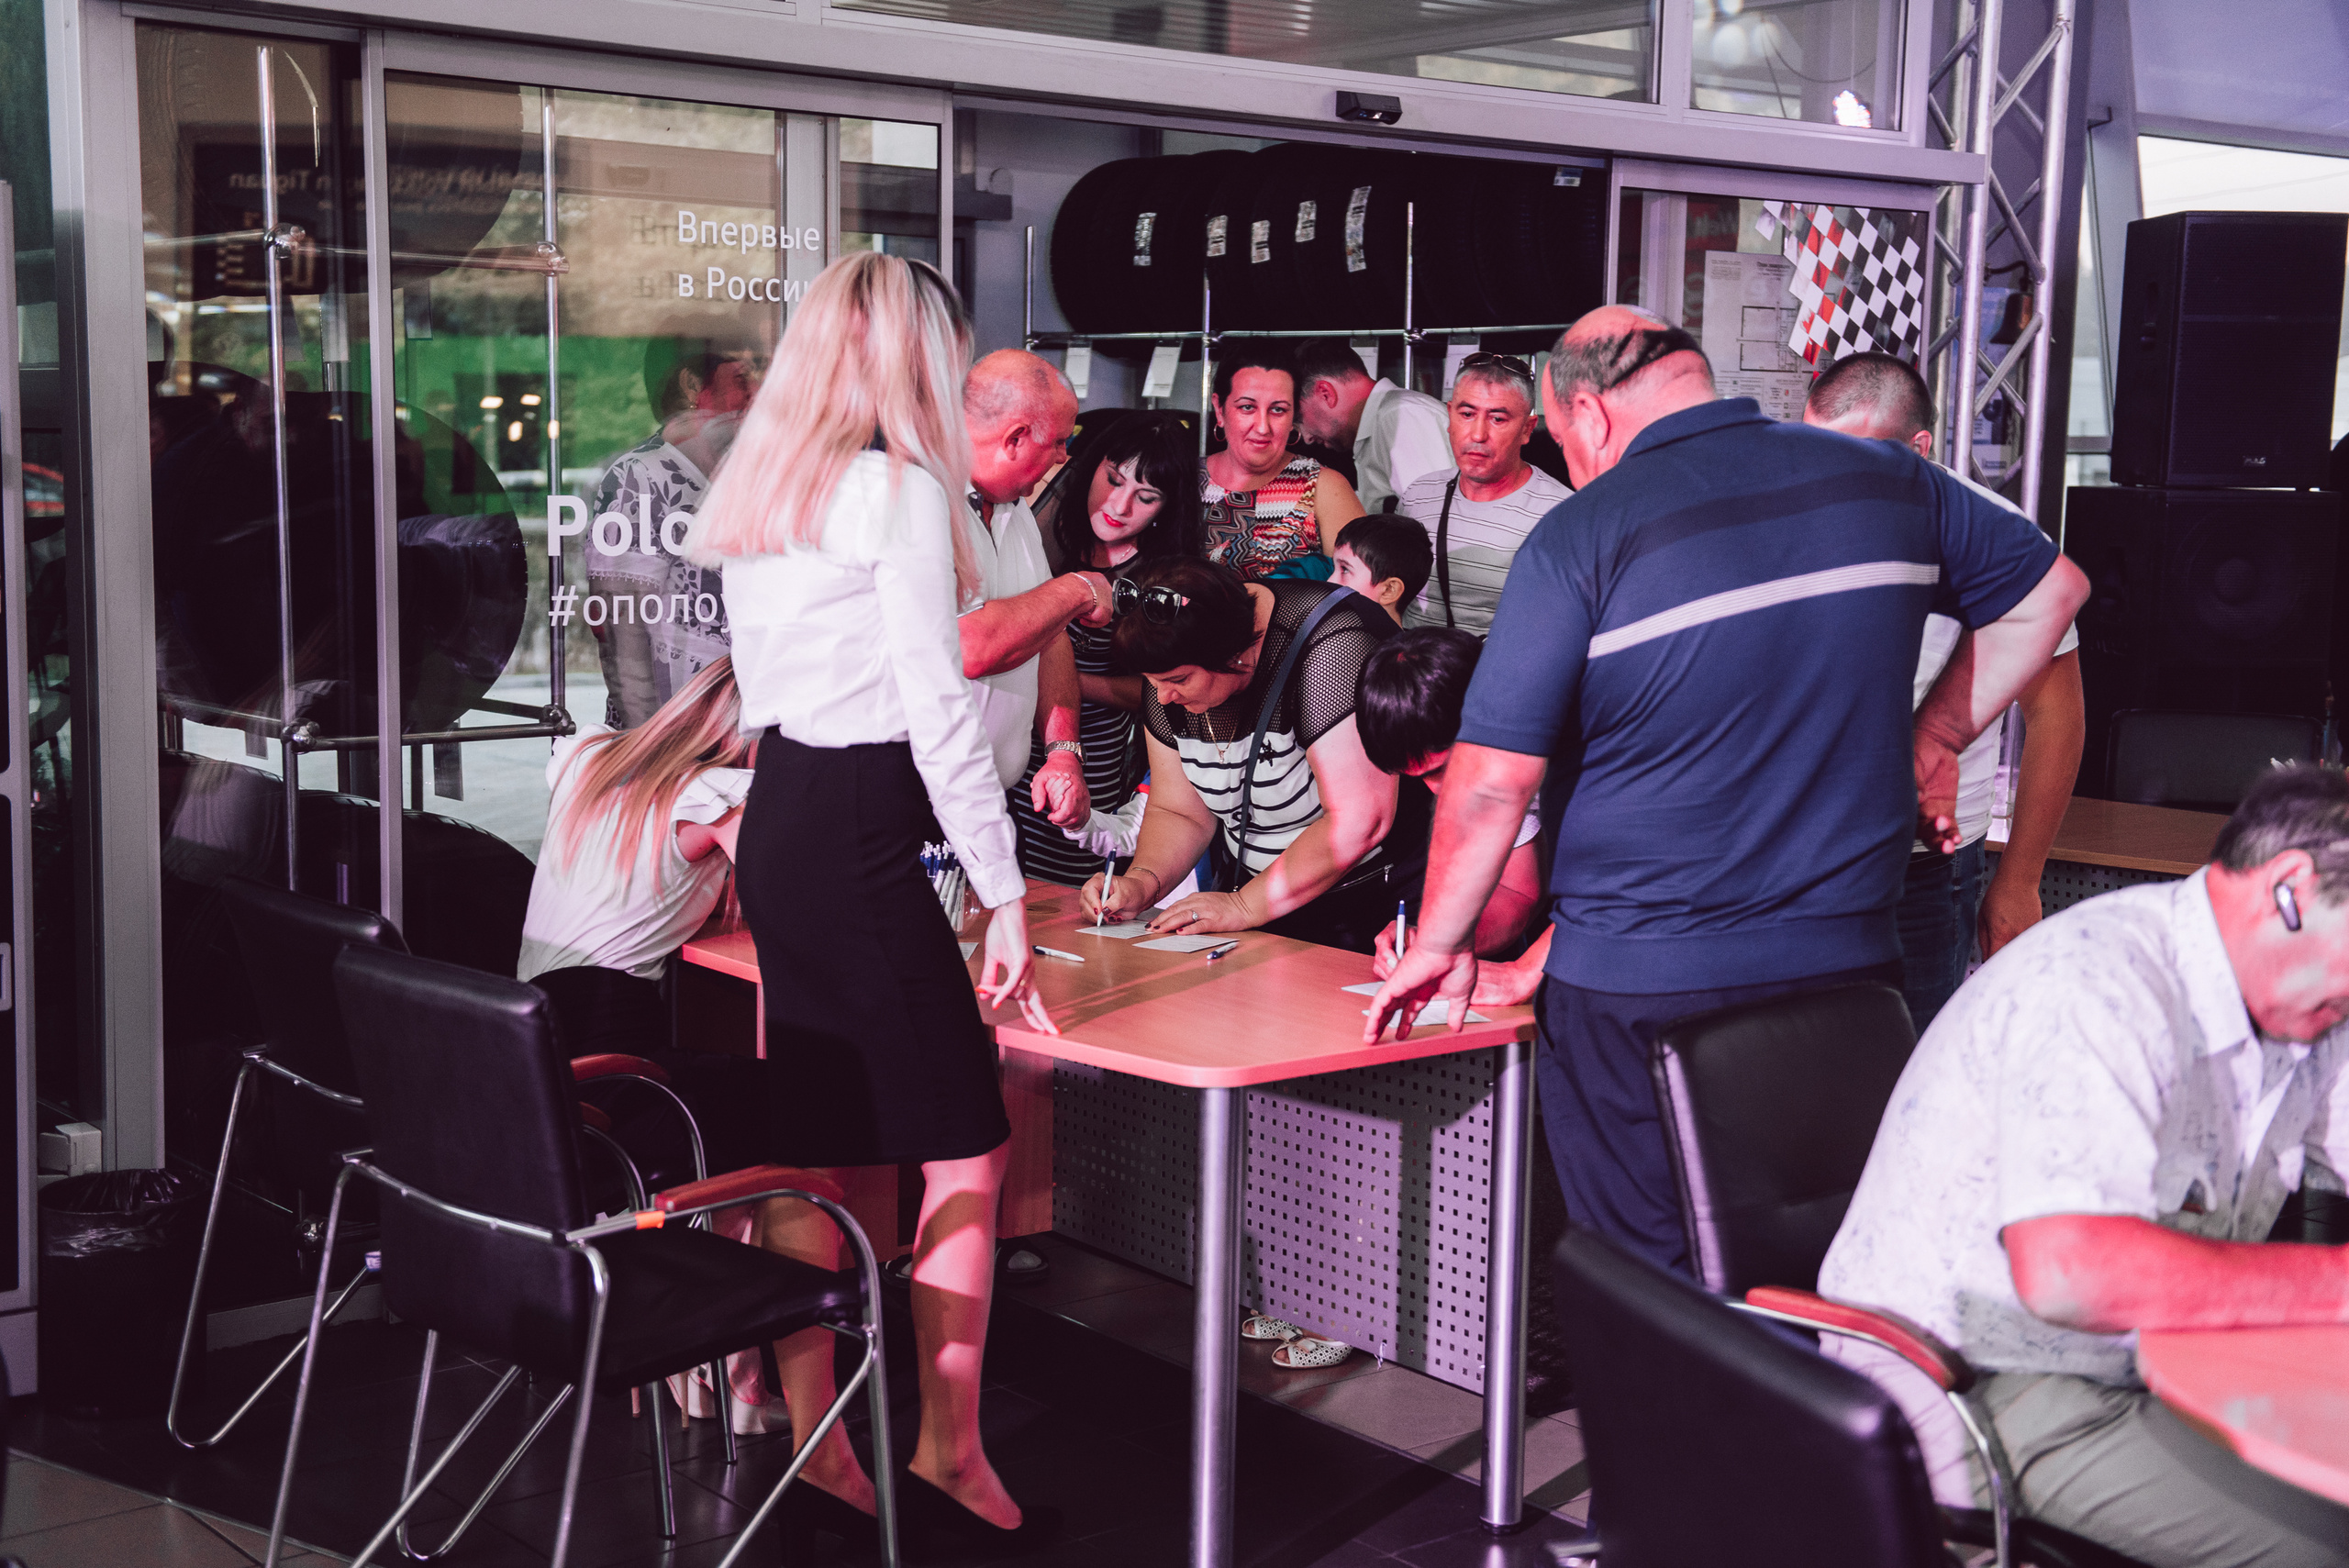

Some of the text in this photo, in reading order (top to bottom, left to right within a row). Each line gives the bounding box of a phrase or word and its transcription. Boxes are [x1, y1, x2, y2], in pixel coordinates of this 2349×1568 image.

[678, 210, 820, 255] Впервые
[678, 273, 695, 297] в
[547, 493, 695, 557] Polo
